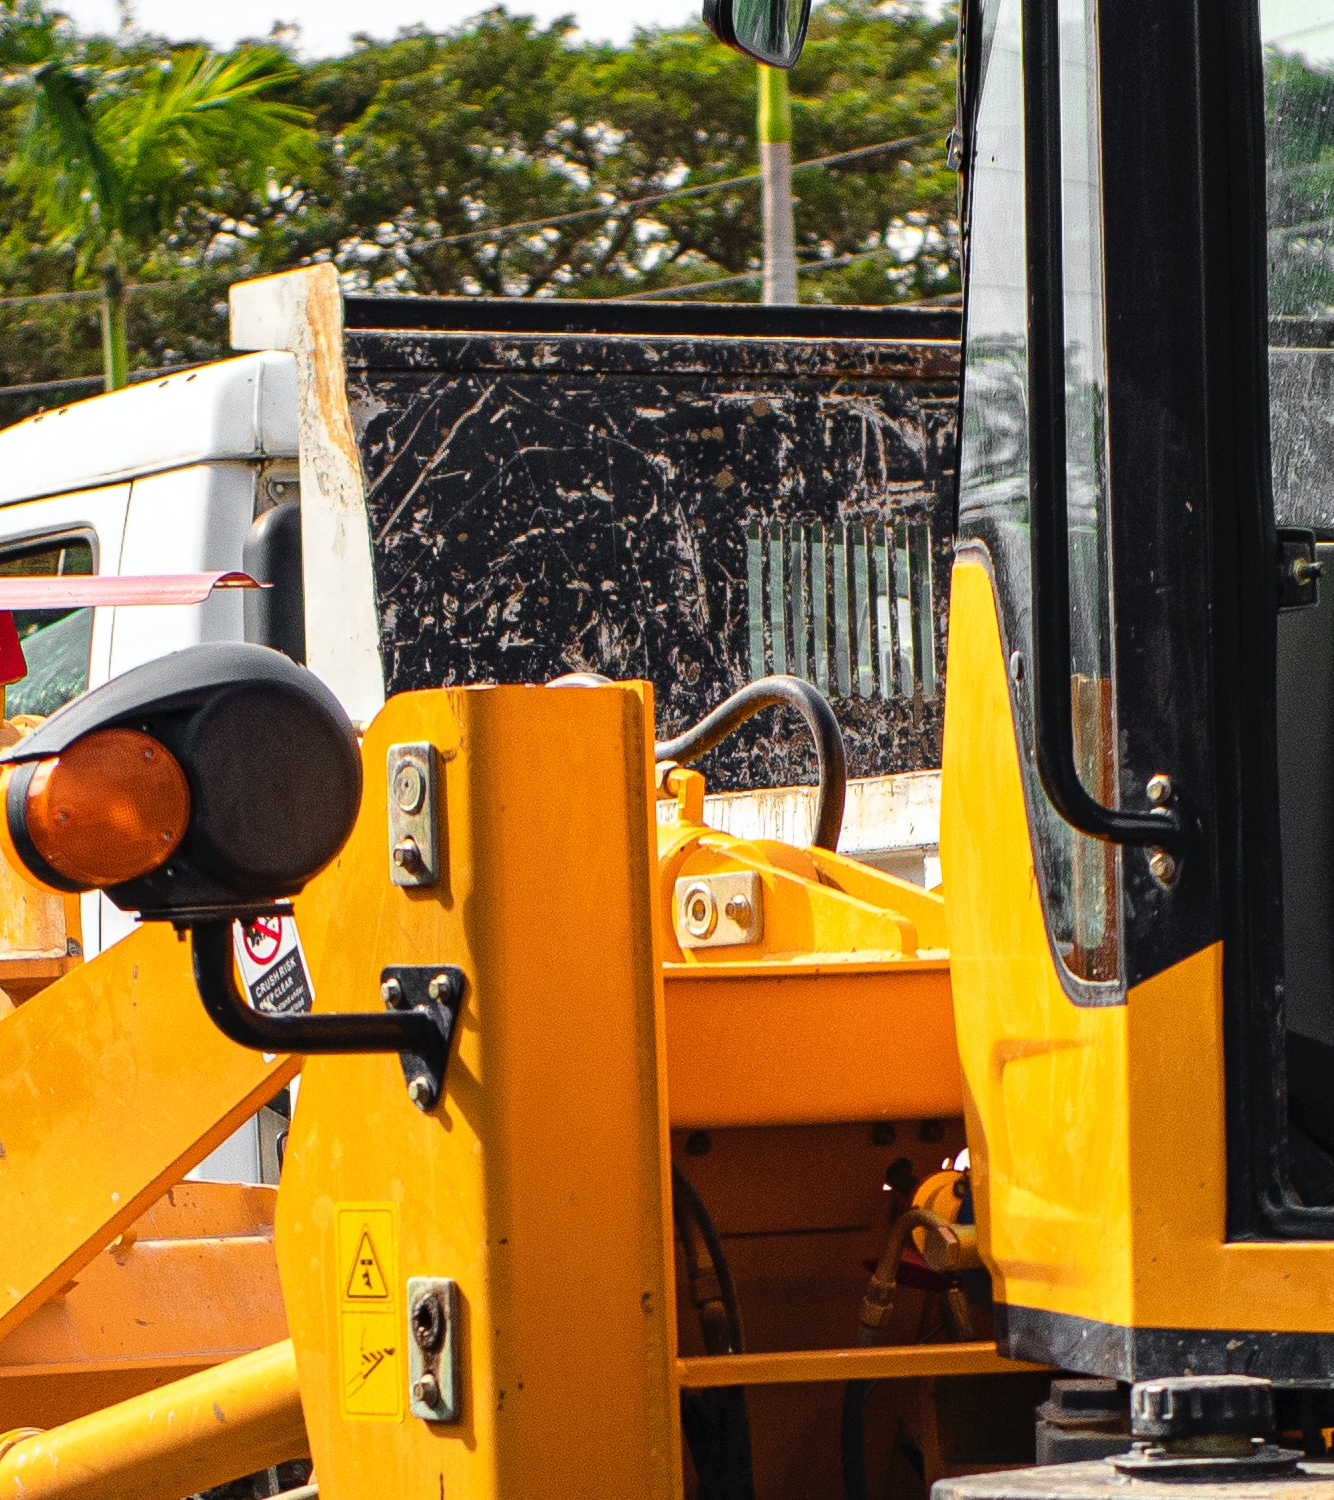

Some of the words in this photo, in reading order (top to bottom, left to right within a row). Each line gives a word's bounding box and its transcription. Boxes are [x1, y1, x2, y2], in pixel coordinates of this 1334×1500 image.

[255, 969, 280, 998] CRUSH
[278, 956, 297, 979] RISK
[272, 976, 294, 999] CLEAR
